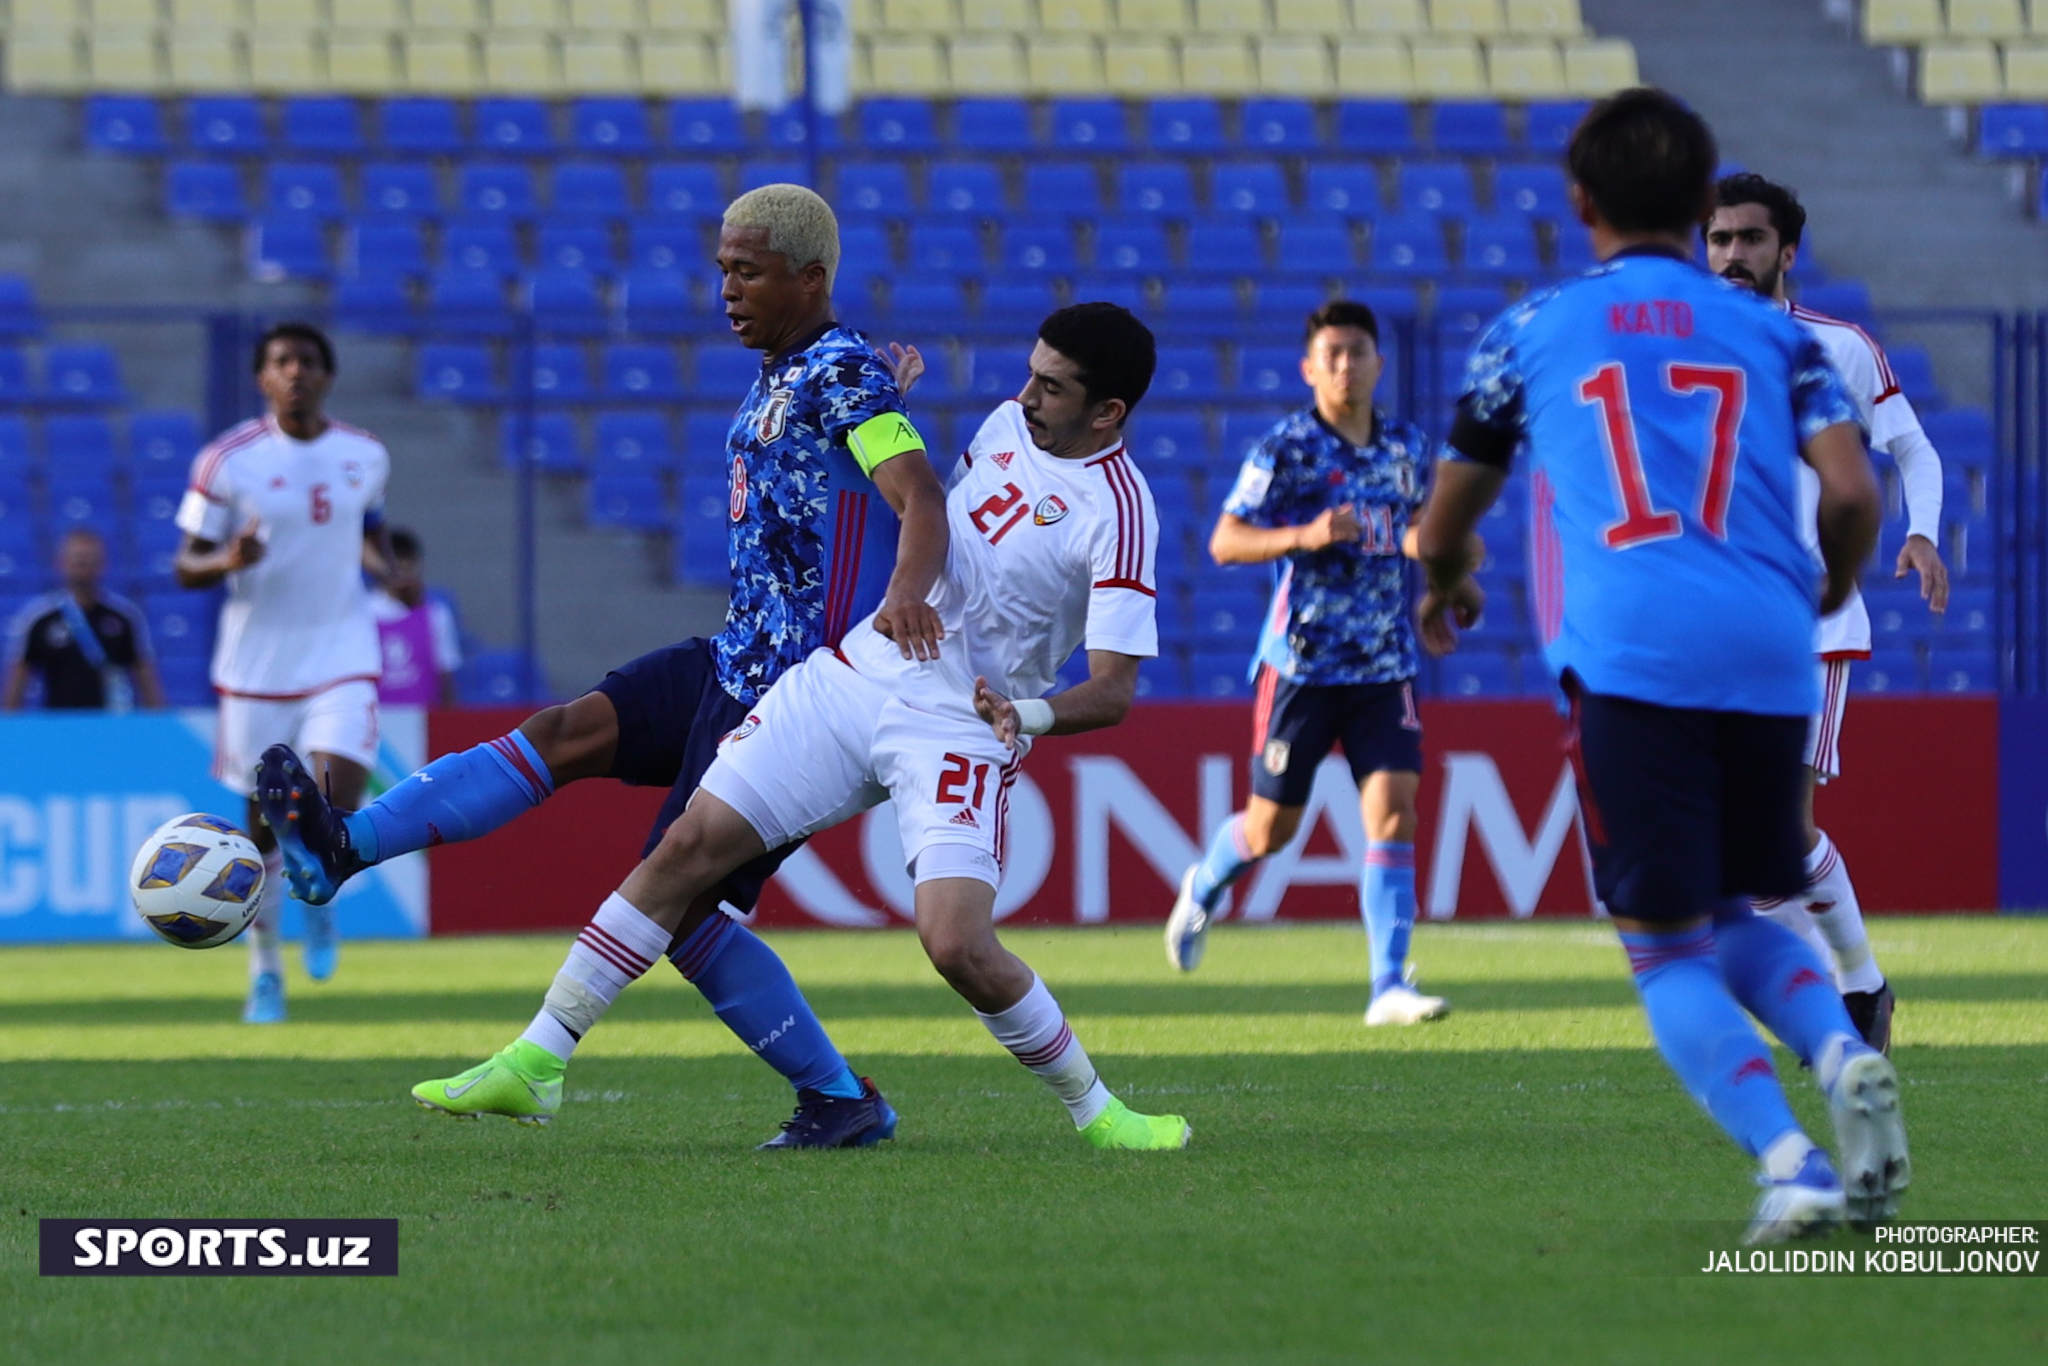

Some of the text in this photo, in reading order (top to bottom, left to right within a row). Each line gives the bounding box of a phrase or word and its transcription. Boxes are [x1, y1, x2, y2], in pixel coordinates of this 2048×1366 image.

[1610, 301, 1694, 338] KATO
[1580, 361, 1748, 550] 17
[309, 483, 333, 525] 6
[730, 454, 747, 522] 8
[969, 482, 1030, 546] 21
[1361, 505, 1397, 555] 11
[936, 752, 989, 811] 21
[949, 818, 981, 830] adidas
